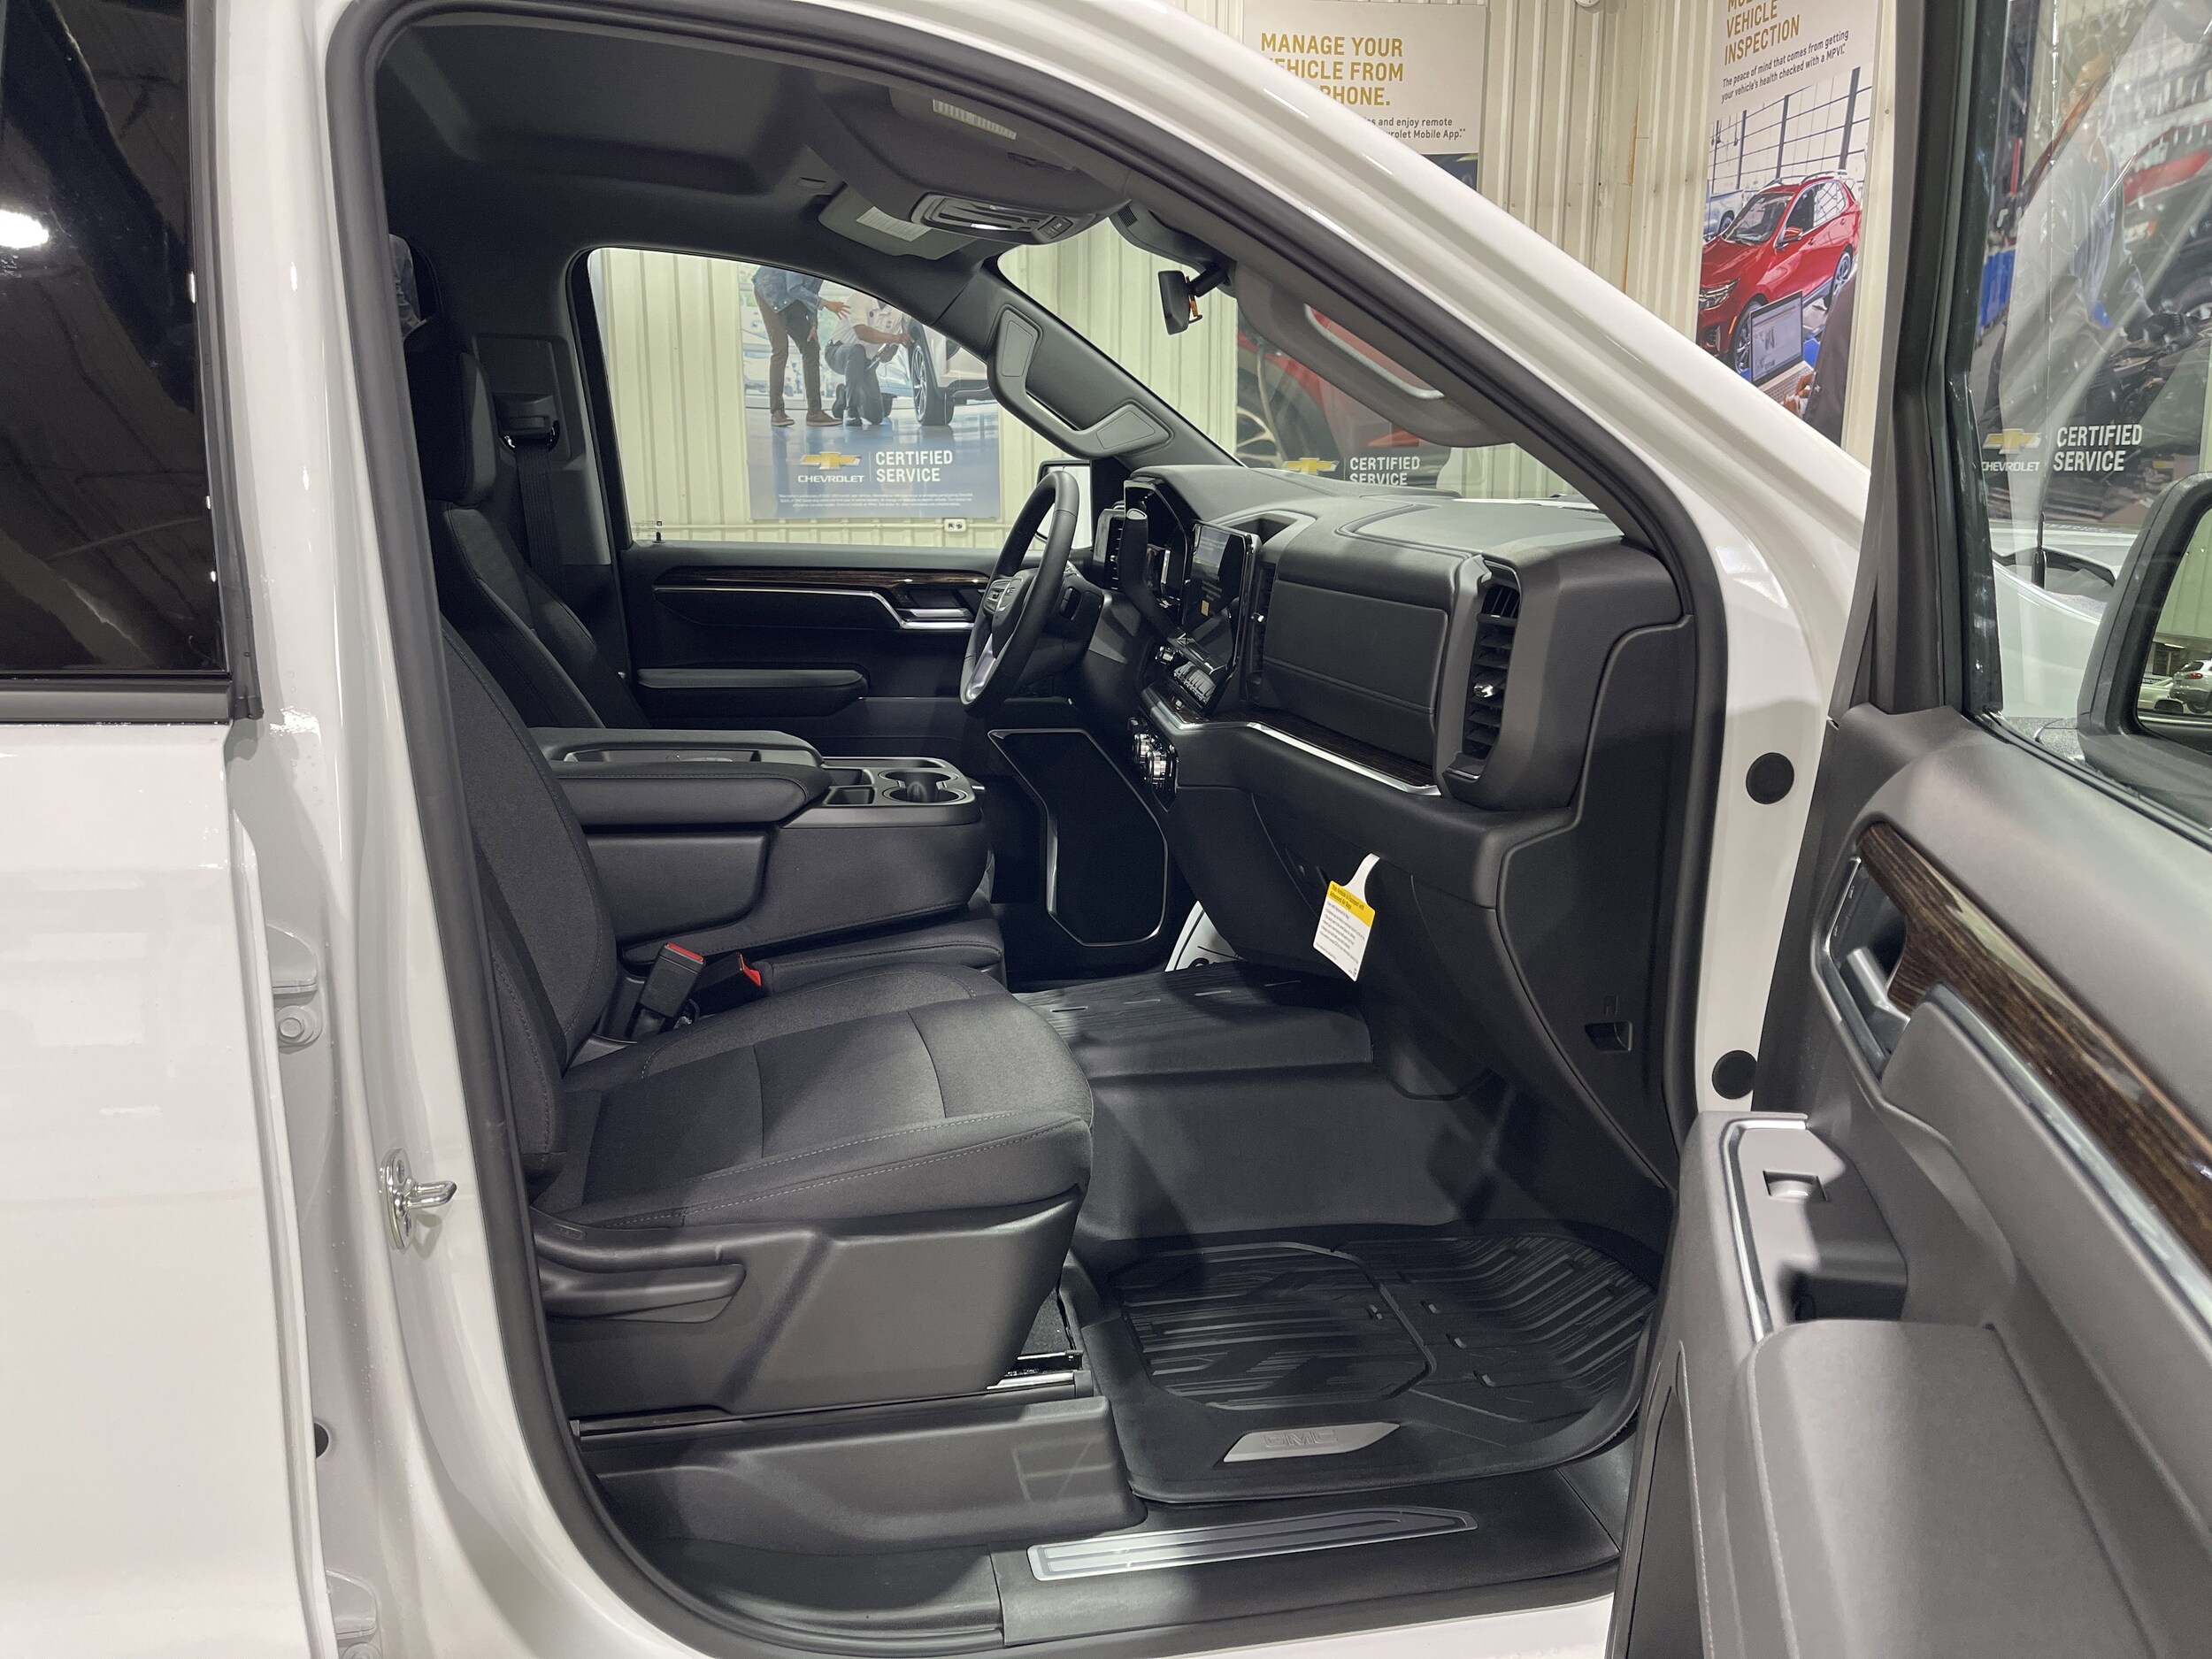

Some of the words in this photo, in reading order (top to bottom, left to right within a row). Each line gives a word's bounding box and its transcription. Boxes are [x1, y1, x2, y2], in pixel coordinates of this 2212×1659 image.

[1726, 2, 1778, 38] VEHICLE
[1261, 33, 1345, 56] MANAGE
[1352, 37, 1403, 57] YOUR
[1724, 14, 1801, 65] INSPECTION
[1723, 78, 1732, 88] The
[1732, 71, 1750, 87] peace
[1751, 65, 1757, 77] of
[1758, 59, 1772, 73] mind
[1773, 54, 1786, 68] that
[1787, 47, 1807, 62] comes
[1808, 41, 1824, 54] from
[1824, 30, 1849, 50] getting
[1270, 58, 1344, 80] HICLE
[1349, 62, 1404, 81] FROM
[1721, 90, 1734, 104] your
[1735, 80, 1758, 96] vehicle's
[1759, 72, 1778, 87] health
[1778, 63, 1804, 80] checked
[1805, 56, 1820, 70] with
[1378, 118, 1394, 127] and
[1396, 118, 1419, 128] enjoy
[1422, 118, 1453, 127] remote
[1414, 130, 1441, 139] Mobile
[2056, 424, 2143, 448] CERTIFIED
[875, 449, 953, 465] CERTIFIED
[1349, 456, 1420, 471] CERTIFIED
[2053, 450, 2126, 472] SERVICE
[797, 474, 864, 483] CHEVROLET
[876, 467, 941, 483] SERVICE
[1349, 472, 1408, 486] SERVICE
[1263, 1429, 1338, 1448] GMC
